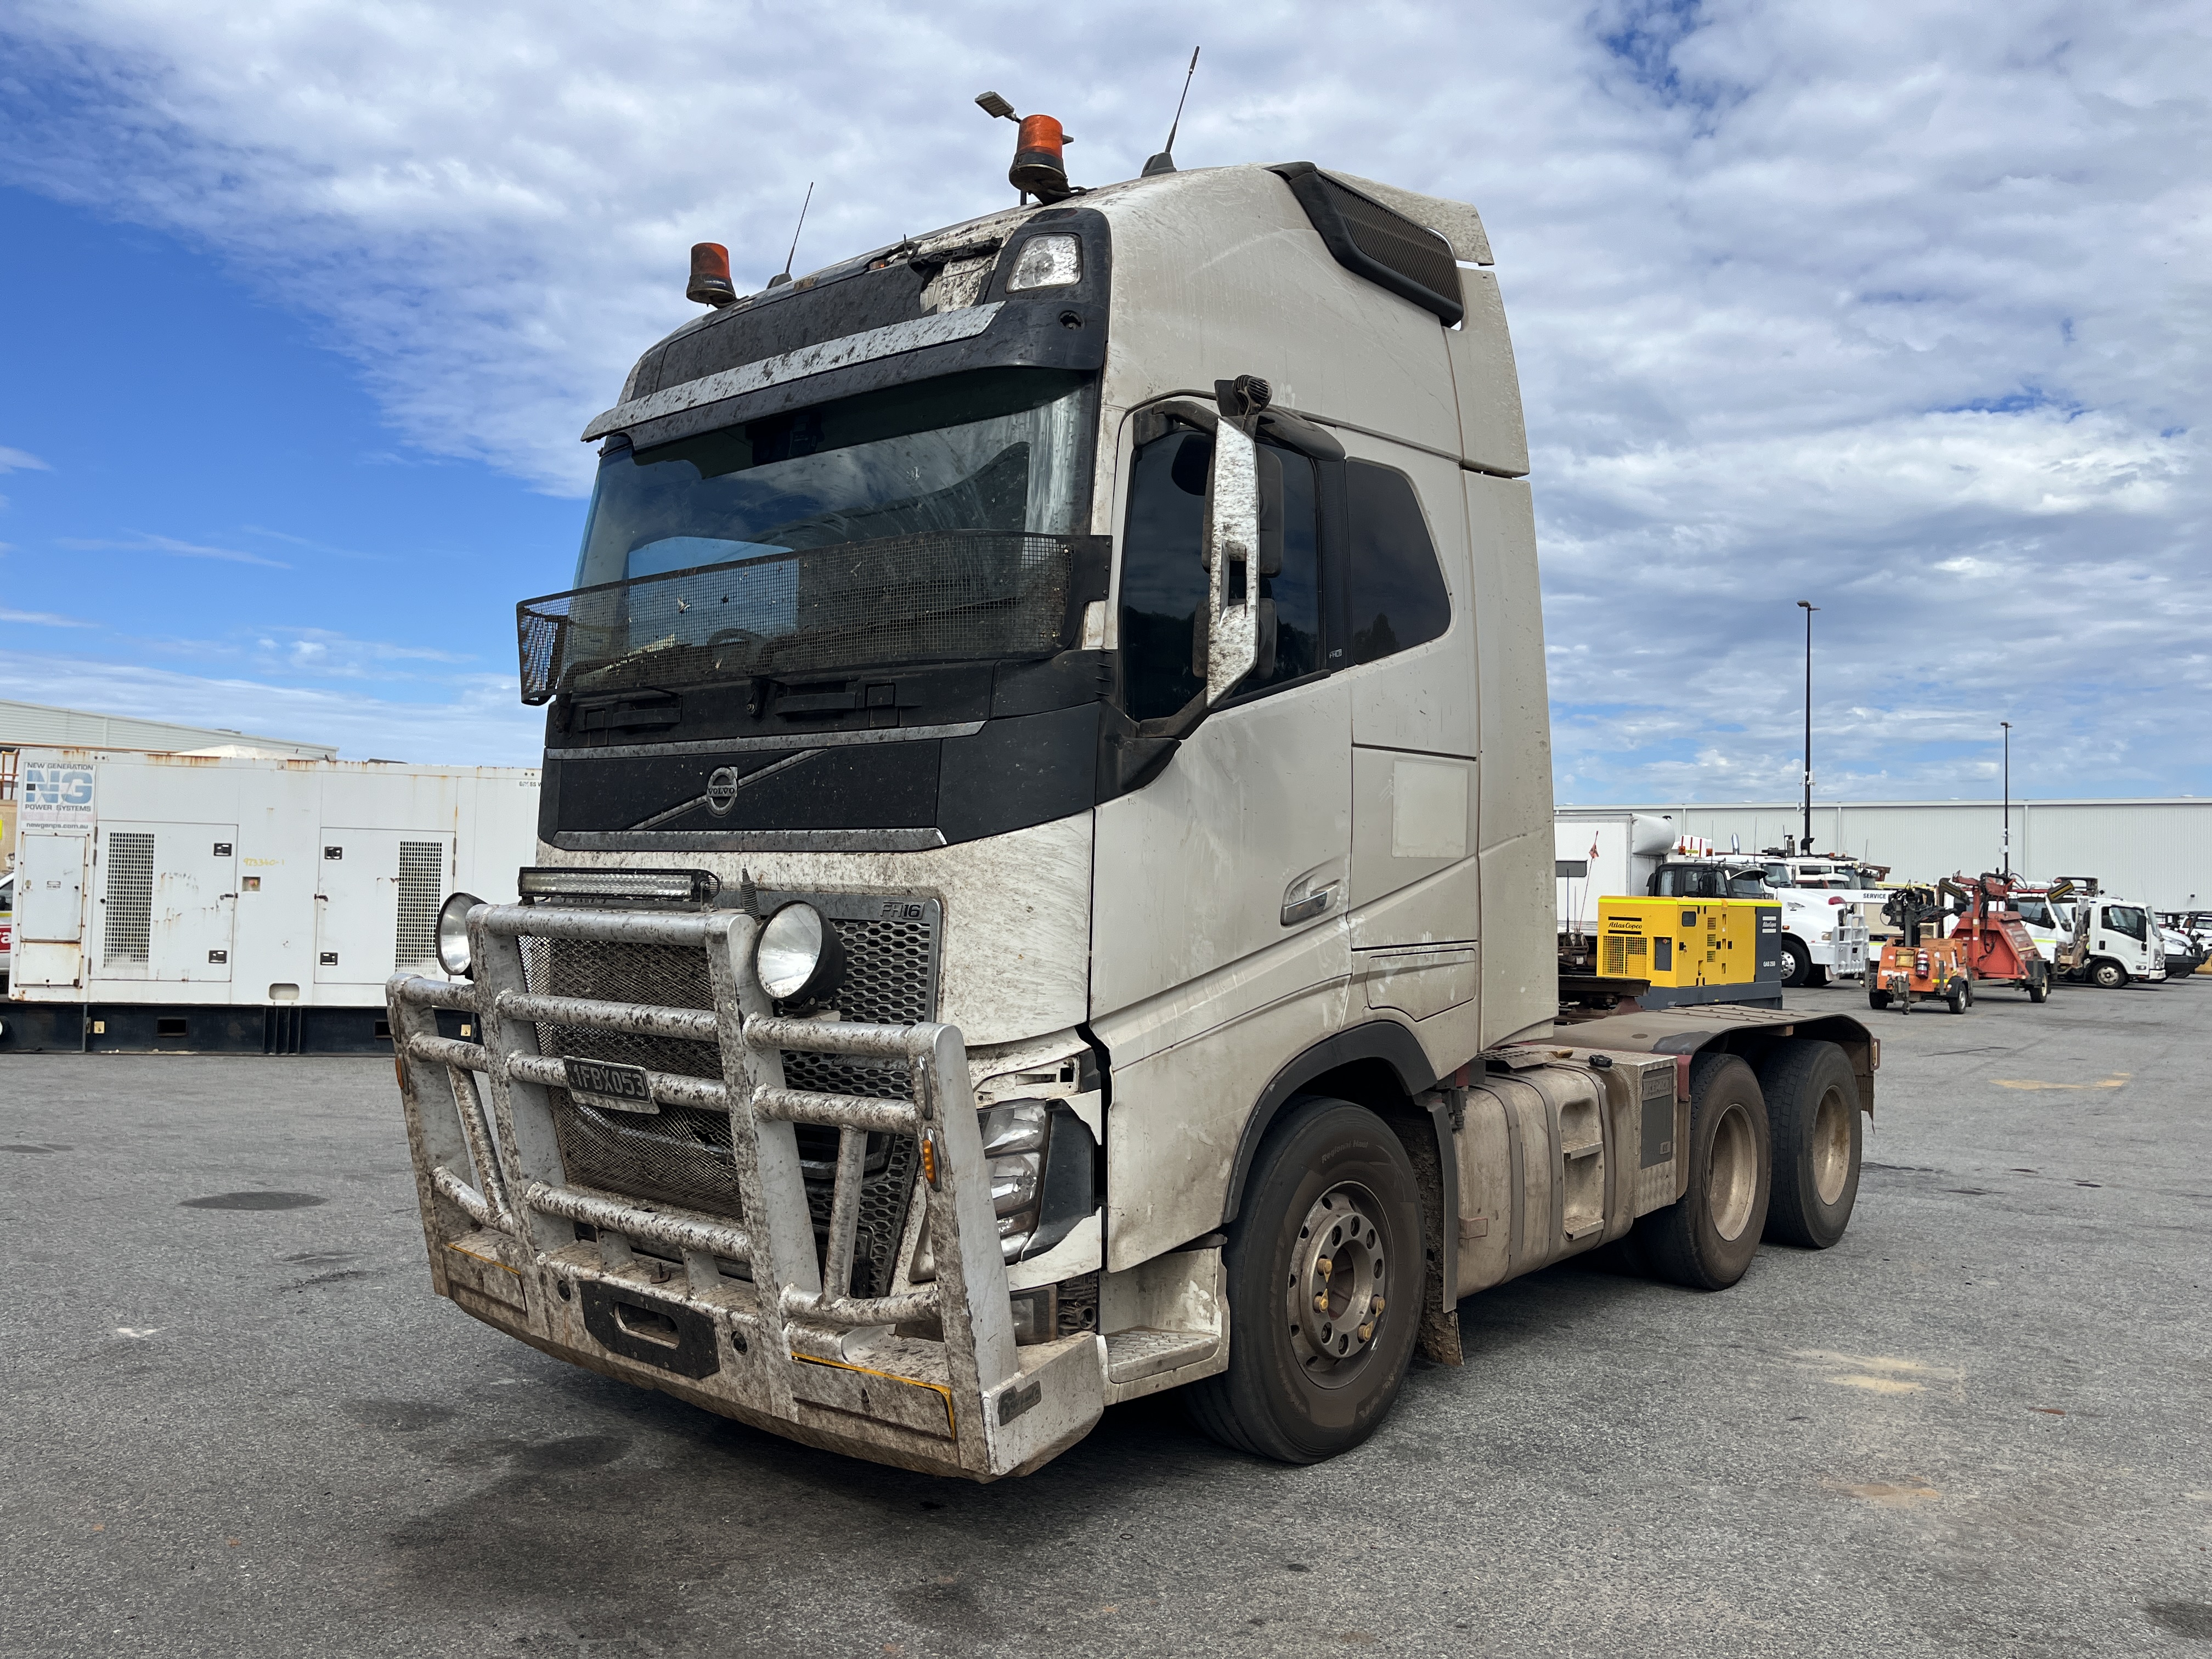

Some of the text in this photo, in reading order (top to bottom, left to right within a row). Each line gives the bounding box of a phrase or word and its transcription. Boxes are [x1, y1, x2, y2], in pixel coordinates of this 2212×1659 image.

[47, 763, 93, 771] GENERATION
[26, 770, 93, 804] NG
[880, 901, 923, 918] FH16
[573, 1064, 646, 1097] 1FBX053
